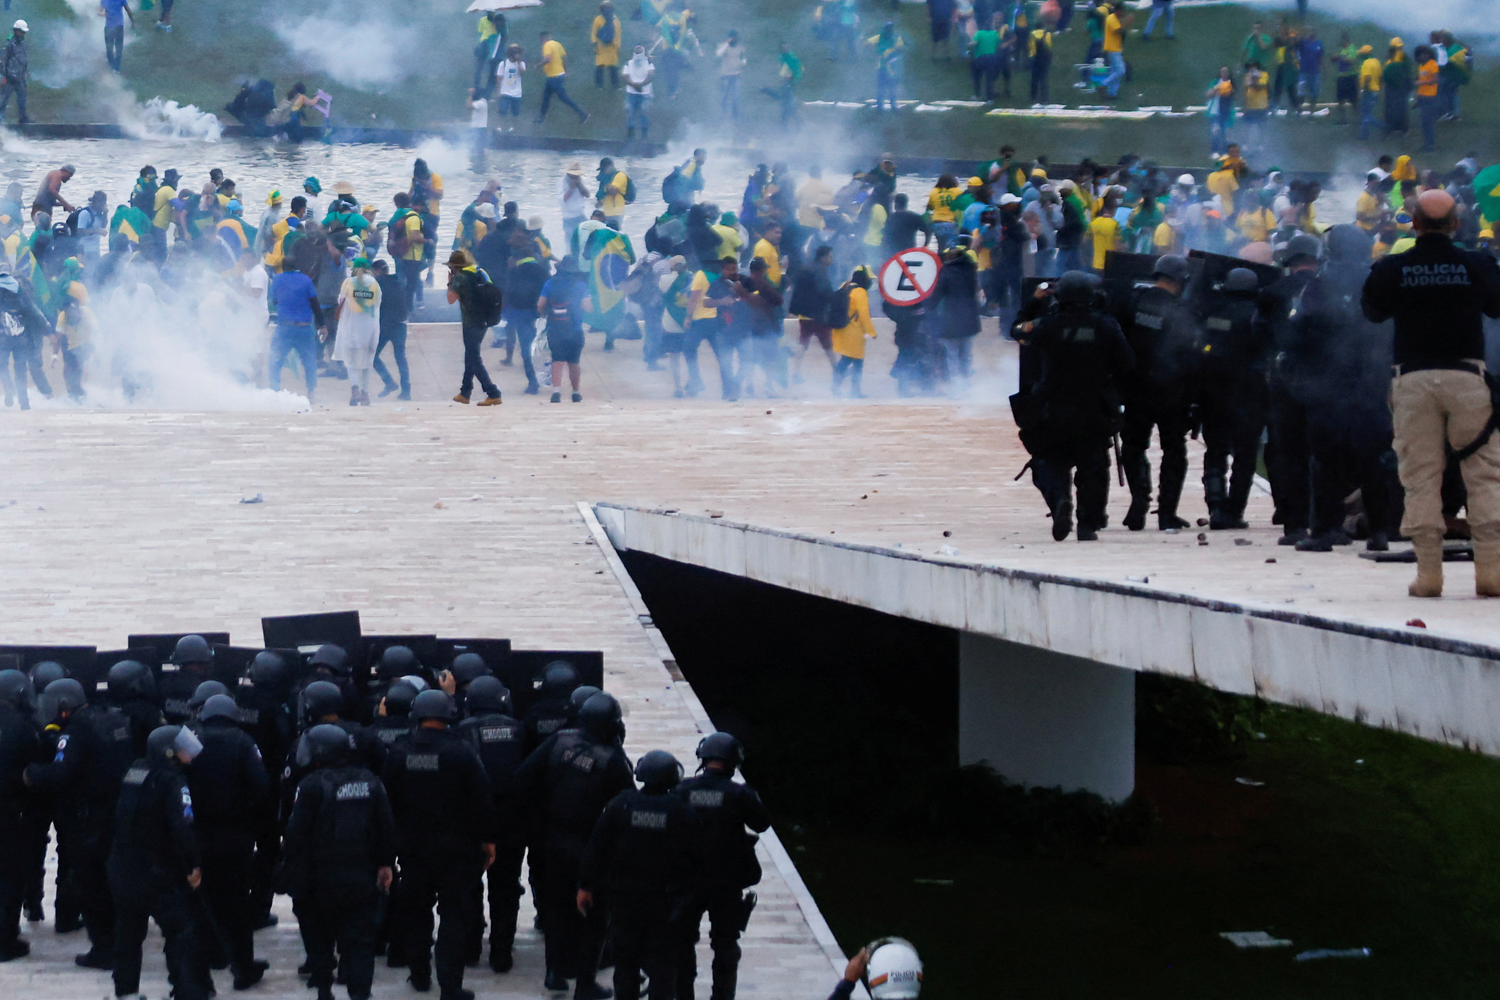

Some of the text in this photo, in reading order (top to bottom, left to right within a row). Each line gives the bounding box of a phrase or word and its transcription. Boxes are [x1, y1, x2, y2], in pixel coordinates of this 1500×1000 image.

[897, 261, 923, 291] E
[1400, 275, 1471, 287] JUDICIAL
[482, 727, 512, 740] CHOQUE
[336, 782, 370, 800] CHOQUE
[689, 790, 724, 808] CHOQUE
[631, 811, 667, 829] CHOQUE
